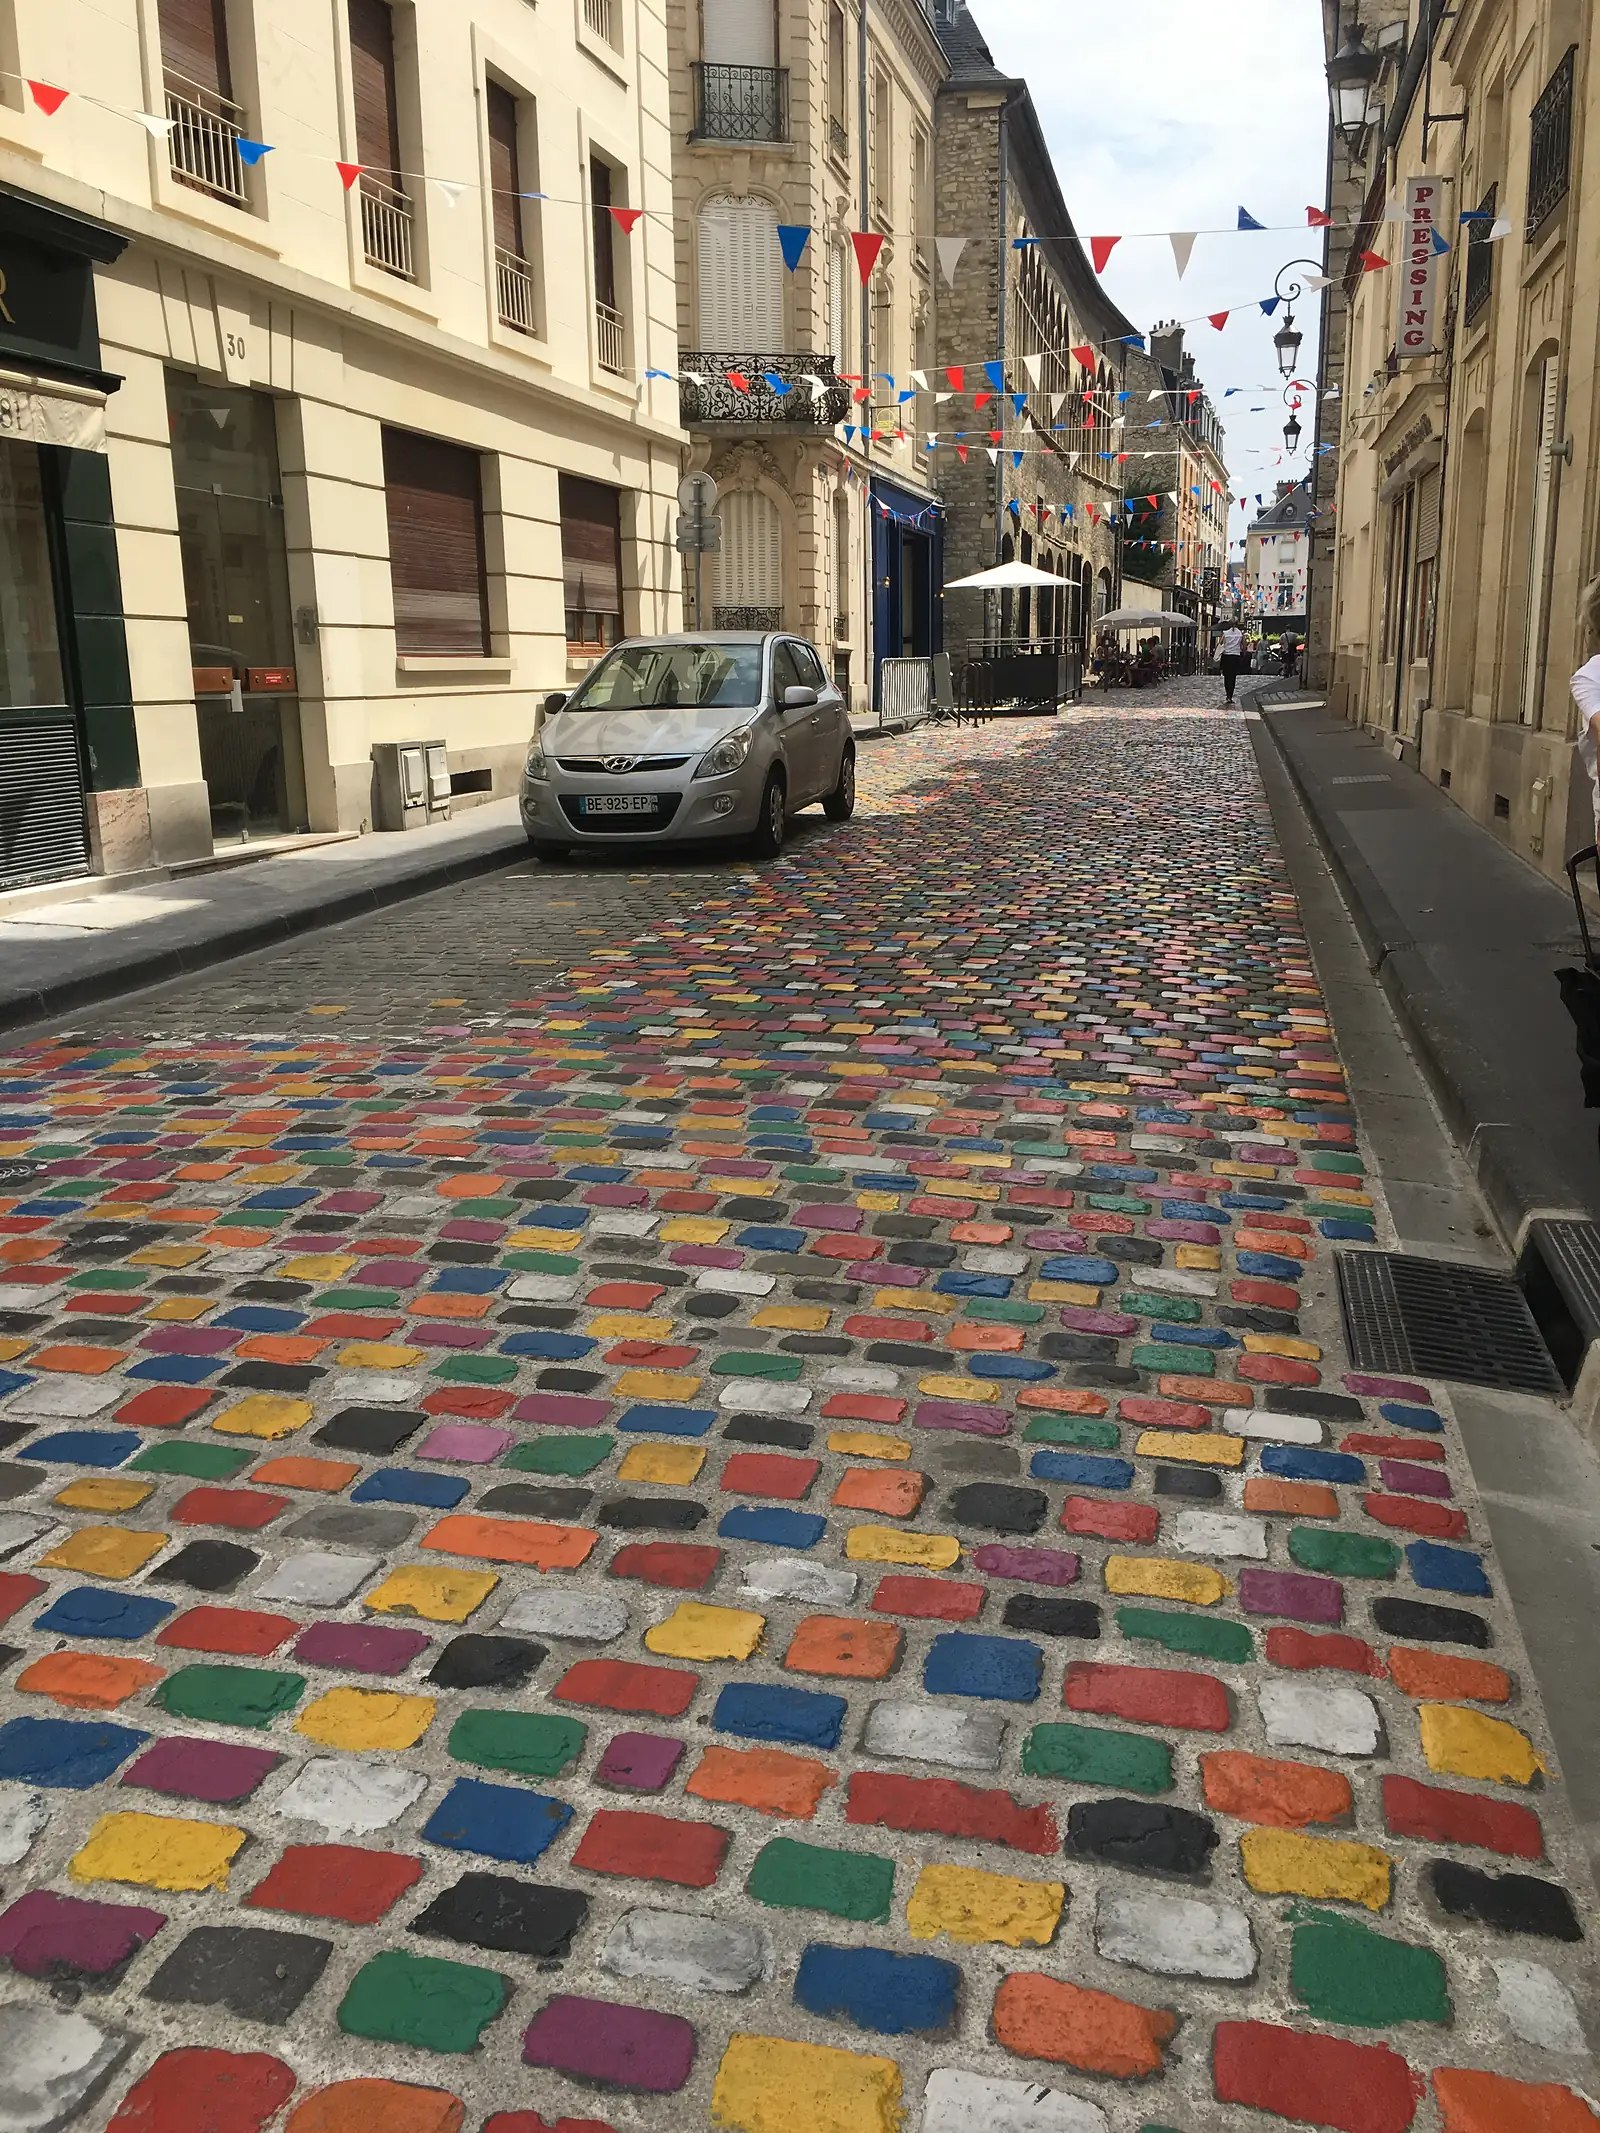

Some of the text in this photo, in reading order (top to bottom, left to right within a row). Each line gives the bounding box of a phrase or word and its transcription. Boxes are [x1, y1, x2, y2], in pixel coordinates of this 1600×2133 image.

[1403, 186, 1434, 347] PRESSING
[226, 332, 246, 360] 30
[587, 796, 648, 811] BE-925-EP
